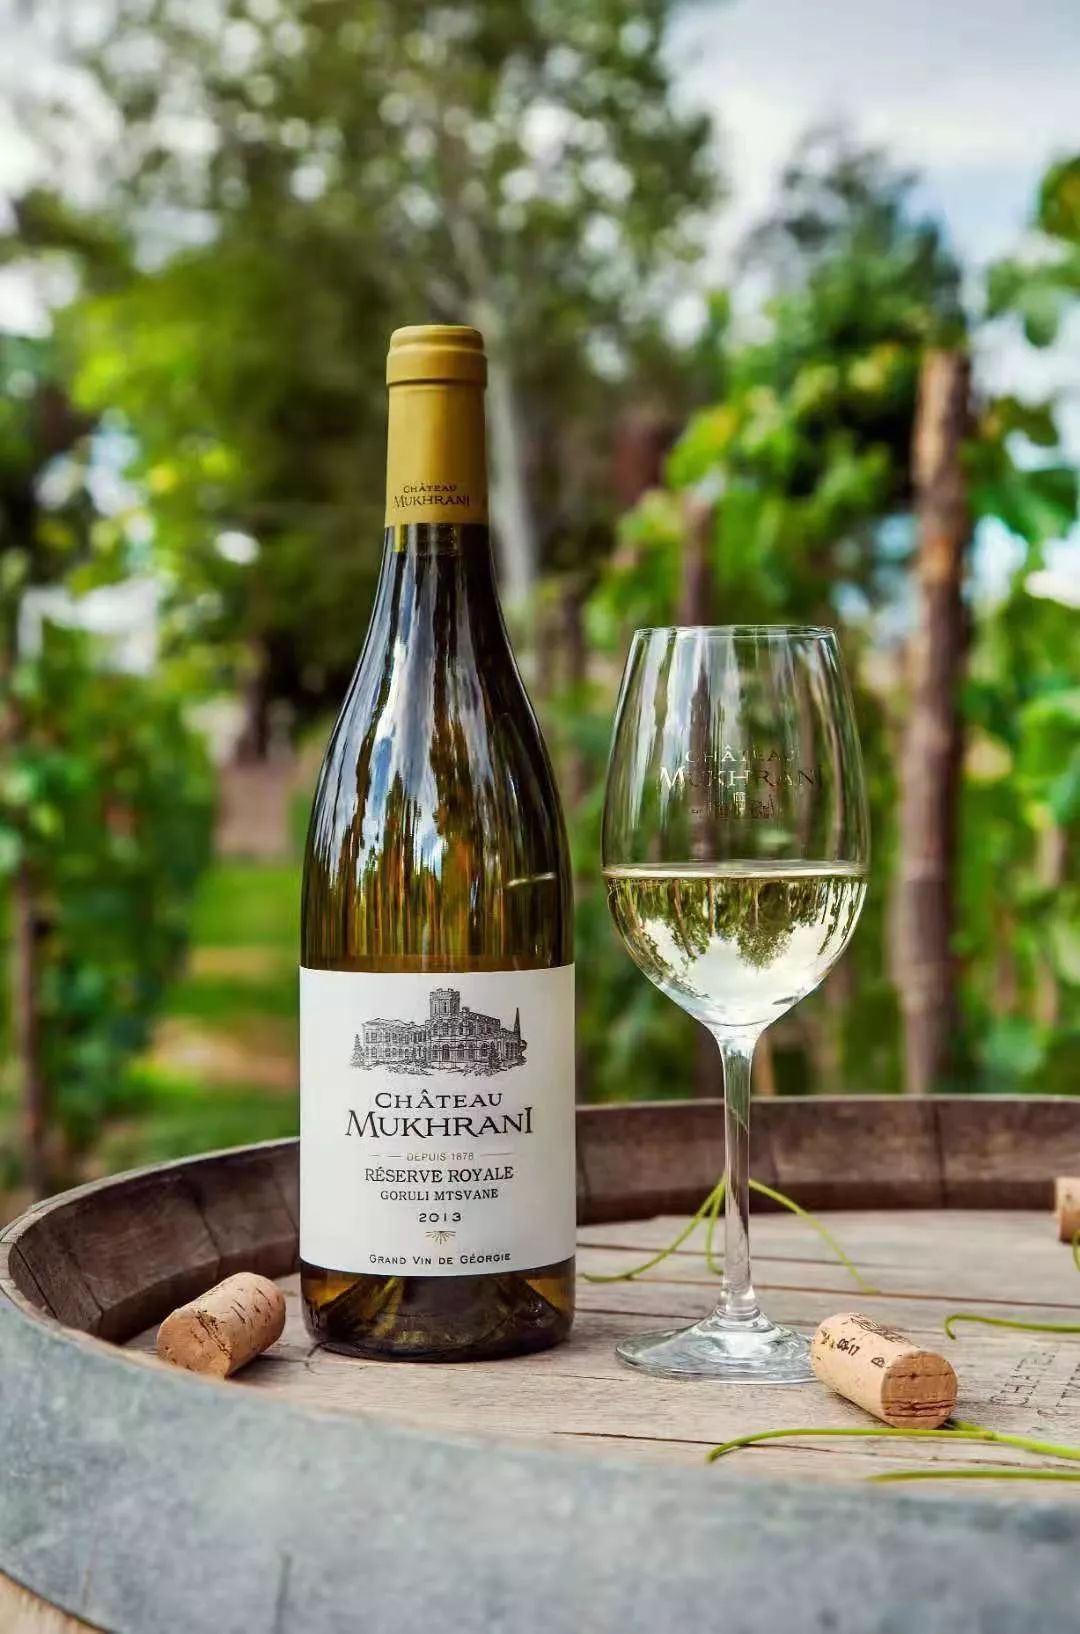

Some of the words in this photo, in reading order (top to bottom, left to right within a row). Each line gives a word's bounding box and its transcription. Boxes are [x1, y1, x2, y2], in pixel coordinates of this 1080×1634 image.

[394, 494, 470, 508] MUKHRANI
[374, 1089, 502, 1108] CHÂTEAU
[344, 1107, 533, 1139] MUKHRANI
[406, 1153, 447, 1162] DEPUIS
[451, 1152, 474, 1161] 1878
[364, 1166, 443, 1183] RÉSERVE
[447, 1166, 514, 1183] ROYALE
[380, 1190, 429, 1201] GORULI
[434, 1189, 499, 1201] MTSVANE
[418, 1211, 463, 1223] 2013
